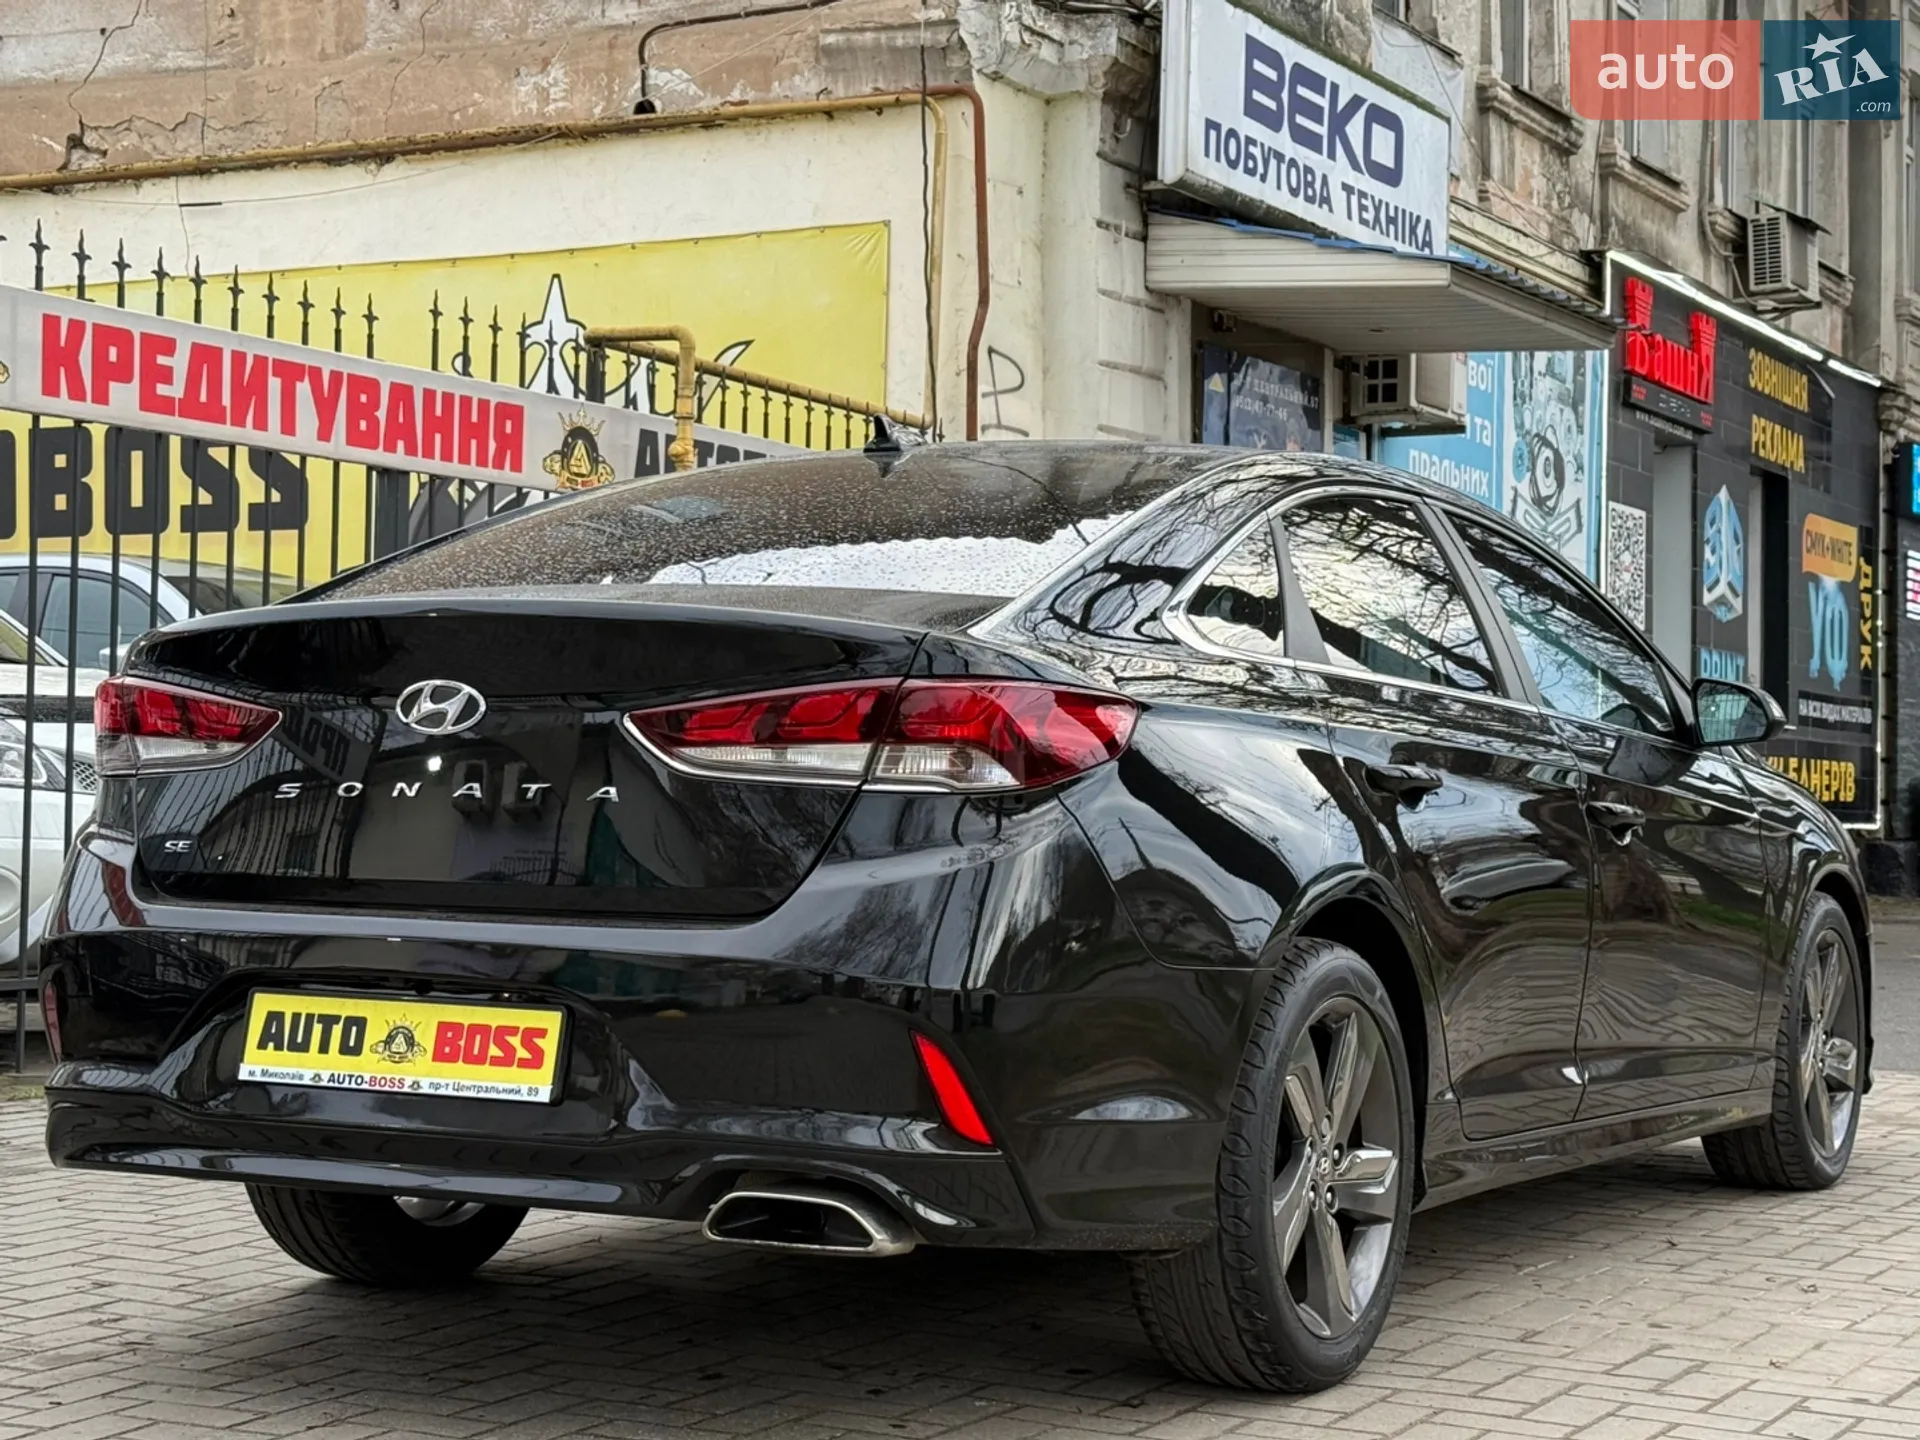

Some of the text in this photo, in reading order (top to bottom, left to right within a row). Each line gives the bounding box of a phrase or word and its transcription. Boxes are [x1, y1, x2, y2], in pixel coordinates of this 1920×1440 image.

[1243, 33, 1404, 189] BEKO
[1204, 117, 1434, 255] ПОБУТОВА ТЕХНІКА
[42, 313, 524, 474] КРЕДИТУВАННЯ
[1749, 348, 1809, 413] ЗОВНІШНЯ
[1474, 416, 1492, 447] та
[1752, 414, 1805, 474] РЕКЛАМА
[1859, 556, 1873, 671] ДРУК
[275, 781, 620, 803] SONATA
[1788, 757, 1855, 802] БАНЕРІВ
[163, 840, 193, 853] SE
[257, 1010, 548, 1070] AUTO BOSS
[260, 1069, 304, 1080] Миколаїв
[327, 1073, 405, 1090] AUTO-BOSS
[428, 1080, 449, 1091] пр-т
[452, 1082, 524, 1097] Центральний,
[527, 1086, 539, 1097] 89
